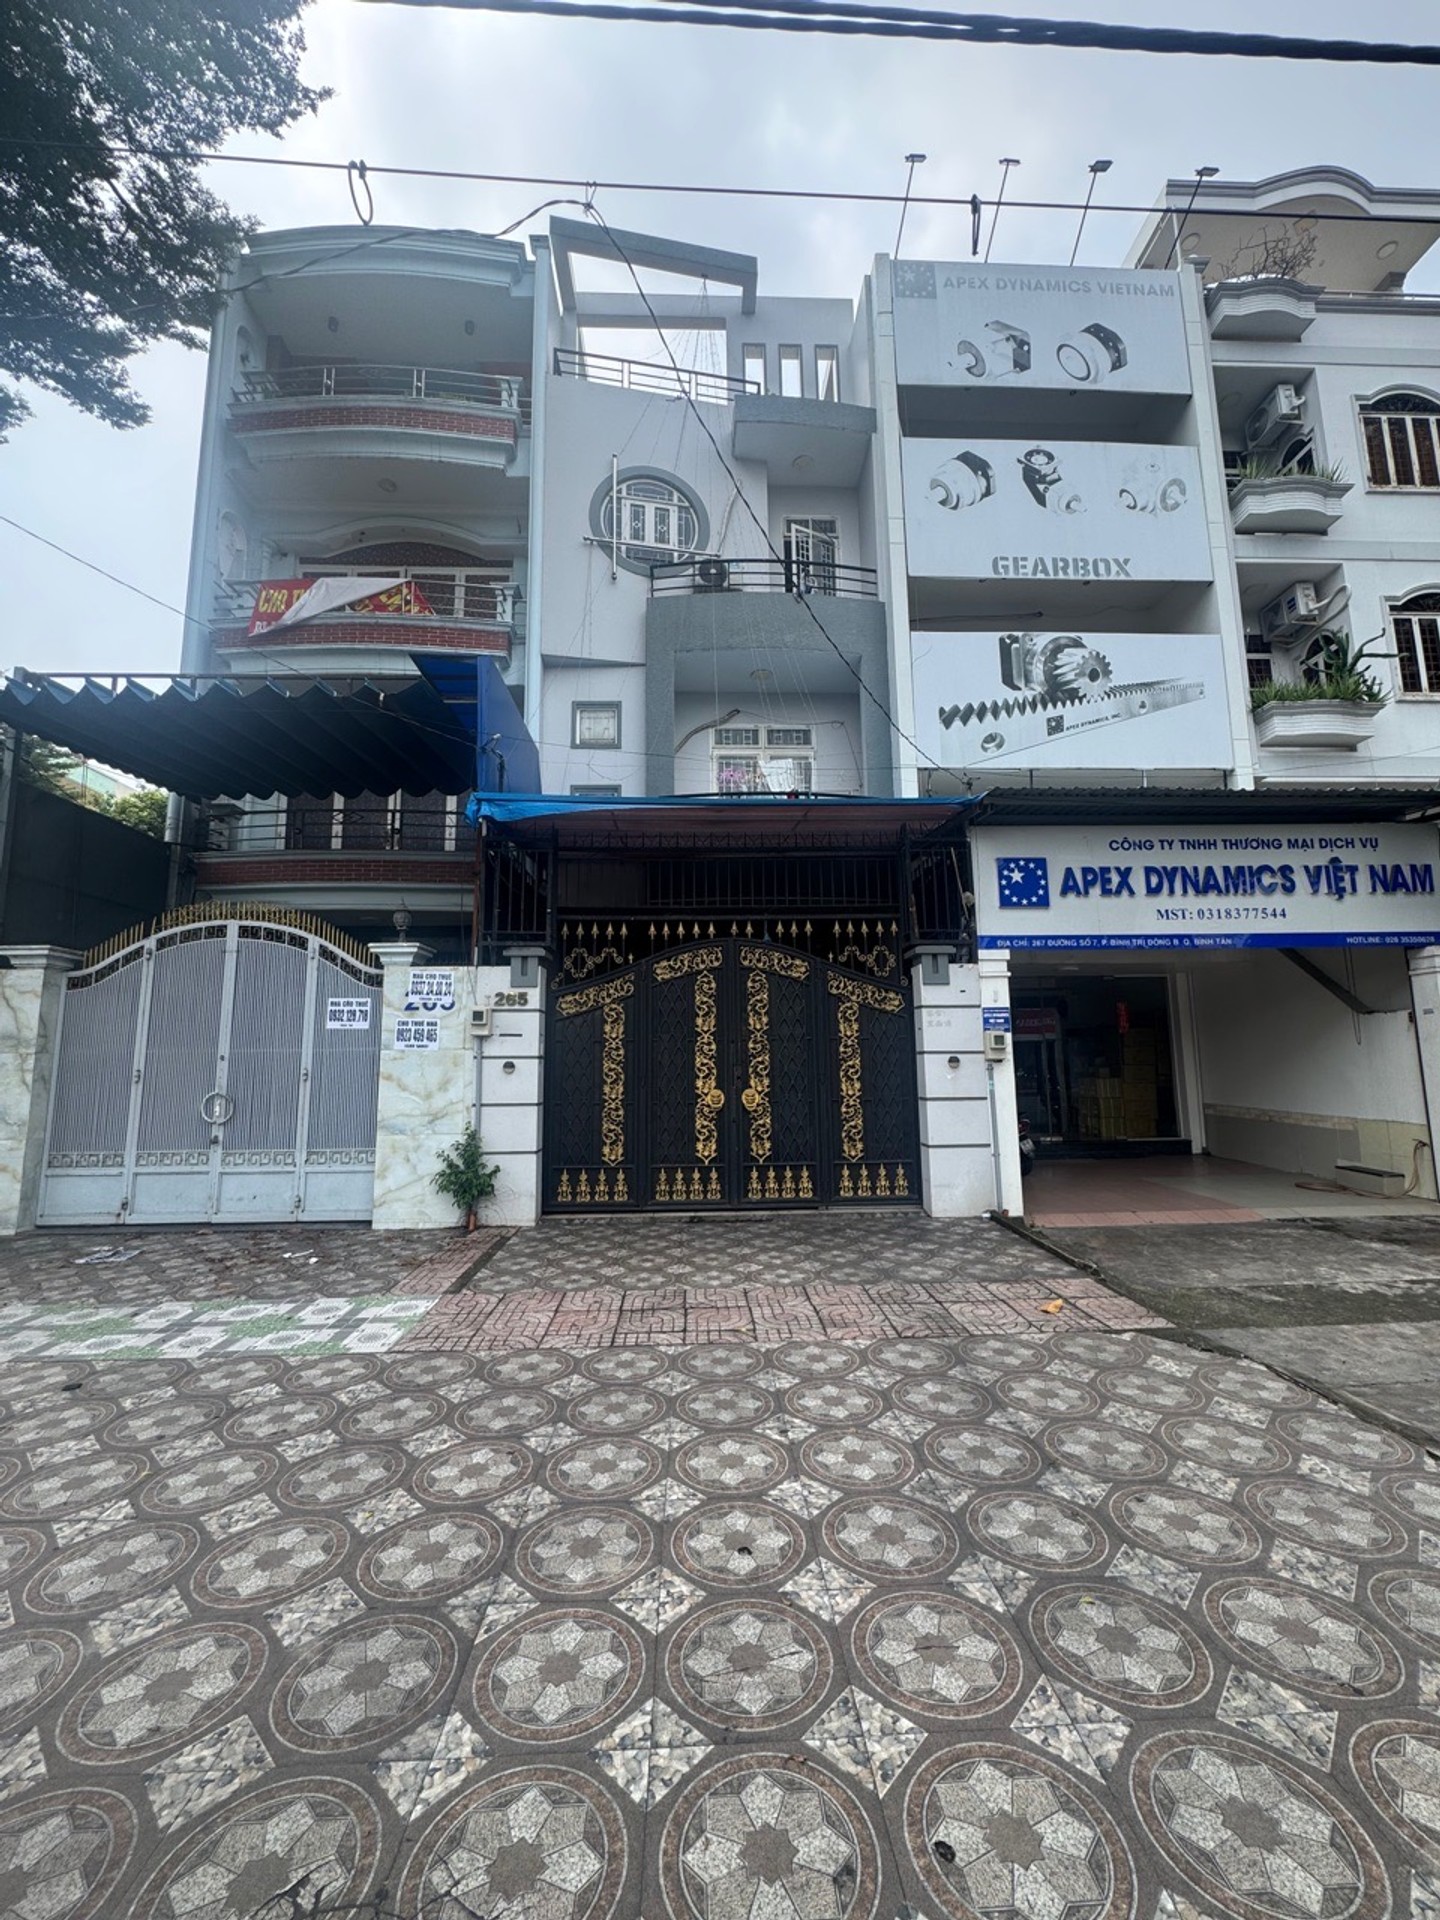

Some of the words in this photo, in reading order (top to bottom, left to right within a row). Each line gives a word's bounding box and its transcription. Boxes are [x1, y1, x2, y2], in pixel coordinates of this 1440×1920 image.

[943, 276, 990, 290] APEX
[995, 278, 1092, 293] DYNAMICS
[1097, 282, 1175, 297] VIETNAM
[991, 556, 1132, 577] GEARBOX
[1108, 837, 1155, 852] CÔNG
[1159, 838, 1175, 851] TY
[1180, 838, 1218, 851] TNHH
[1221, 836, 1283, 851] THƯƠNG
[1287, 837, 1314, 853] MẠI
[1318, 837, 1356, 853] DỊCH
[1360, 837, 1379, 852] VỤ
[1059, 866, 1136, 897] APEX
[1143, 864, 1296, 896] DYNAMICS
[1303, 856, 1359, 900] VIỆT
[1369, 863, 1436, 895] NAM
[1156, 908, 1193, 920] MST:
[1197, 907, 1287, 920] 0318377544
[494, 991, 528, 1007] 265
